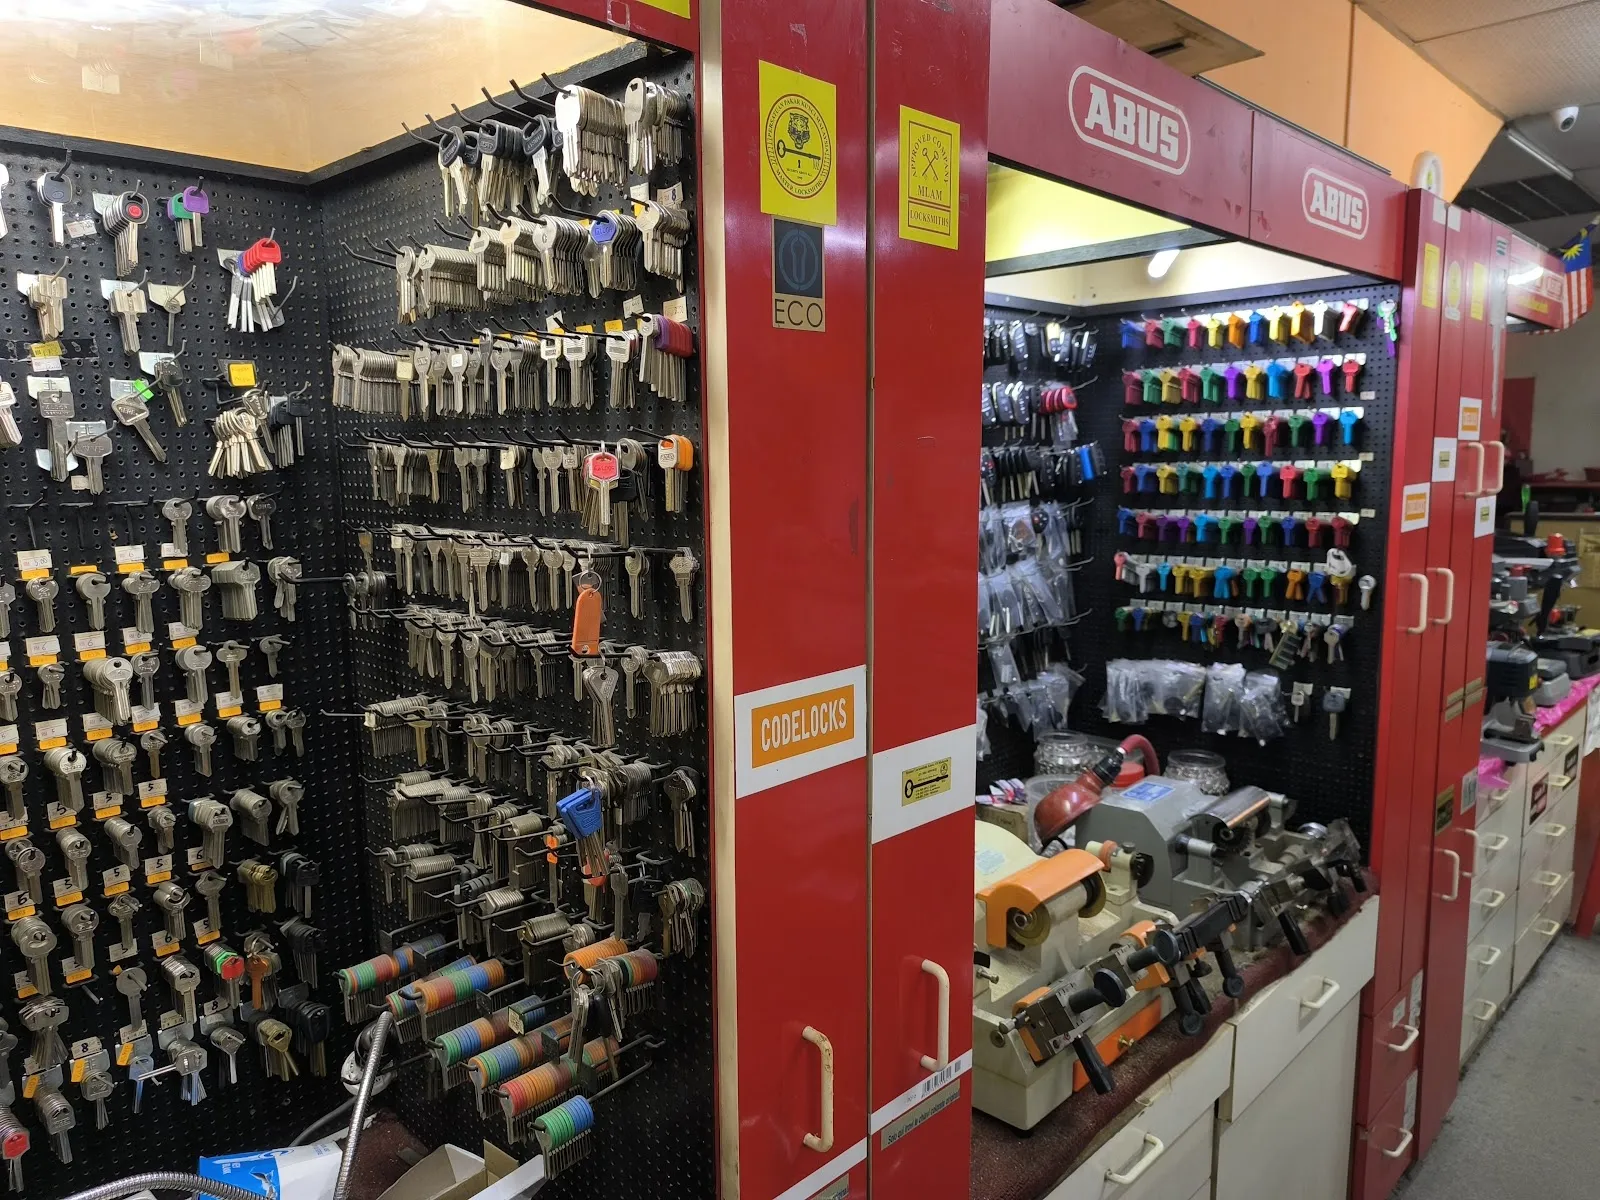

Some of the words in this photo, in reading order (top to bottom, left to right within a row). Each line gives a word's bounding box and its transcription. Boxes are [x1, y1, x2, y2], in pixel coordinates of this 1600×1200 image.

[1084, 83, 1179, 162] ABUS
[909, 133, 931, 178] APPROVED
[932, 137, 951, 185] COMPANY
[917, 185, 943, 202] MLAM
[1309, 180, 1364, 231] ABUS
[910, 209, 950, 227] LOCKSMITHS
[774, 299, 823, 329] ECO
[87, 638, 94, 647] 6
[761, 697, 848, 752] CODELOCKS
[147, 783, 154, 792] 5
[105, 792, 113, 803] 5
[56, 803, 67, 815] 5
[196, 849, 203, 860] 6
[155, 859, 164, 869] 5
[113, 867, 120, 877] 5
[211, 1000, 219, 1010] 8
[81, 1042, 89, 1053] 8
